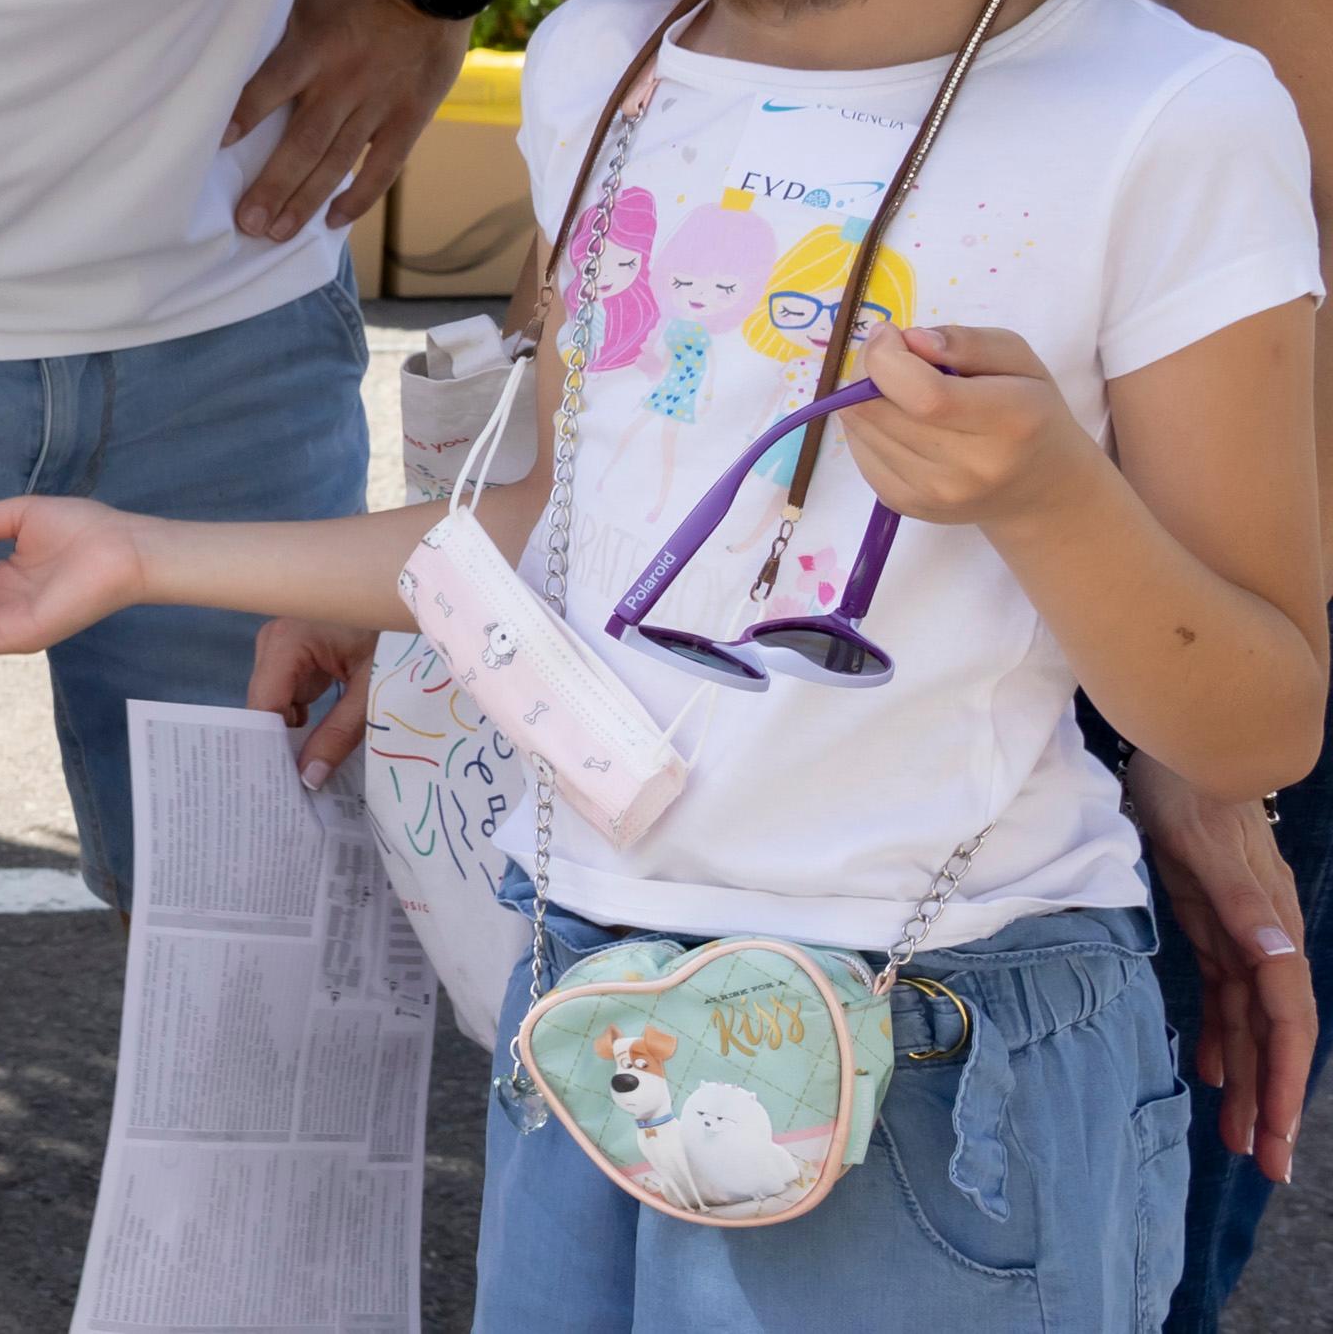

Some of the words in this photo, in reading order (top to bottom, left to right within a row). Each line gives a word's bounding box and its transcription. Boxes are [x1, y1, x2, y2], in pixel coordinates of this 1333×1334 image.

[624, 550, 677, 611] Polaroid
[400, 898, 430, 914] USIC
[720, 989, 749, 1001] RISK
[751, 982, 774, 992] FOR
[777, 979, 787, 987] A
